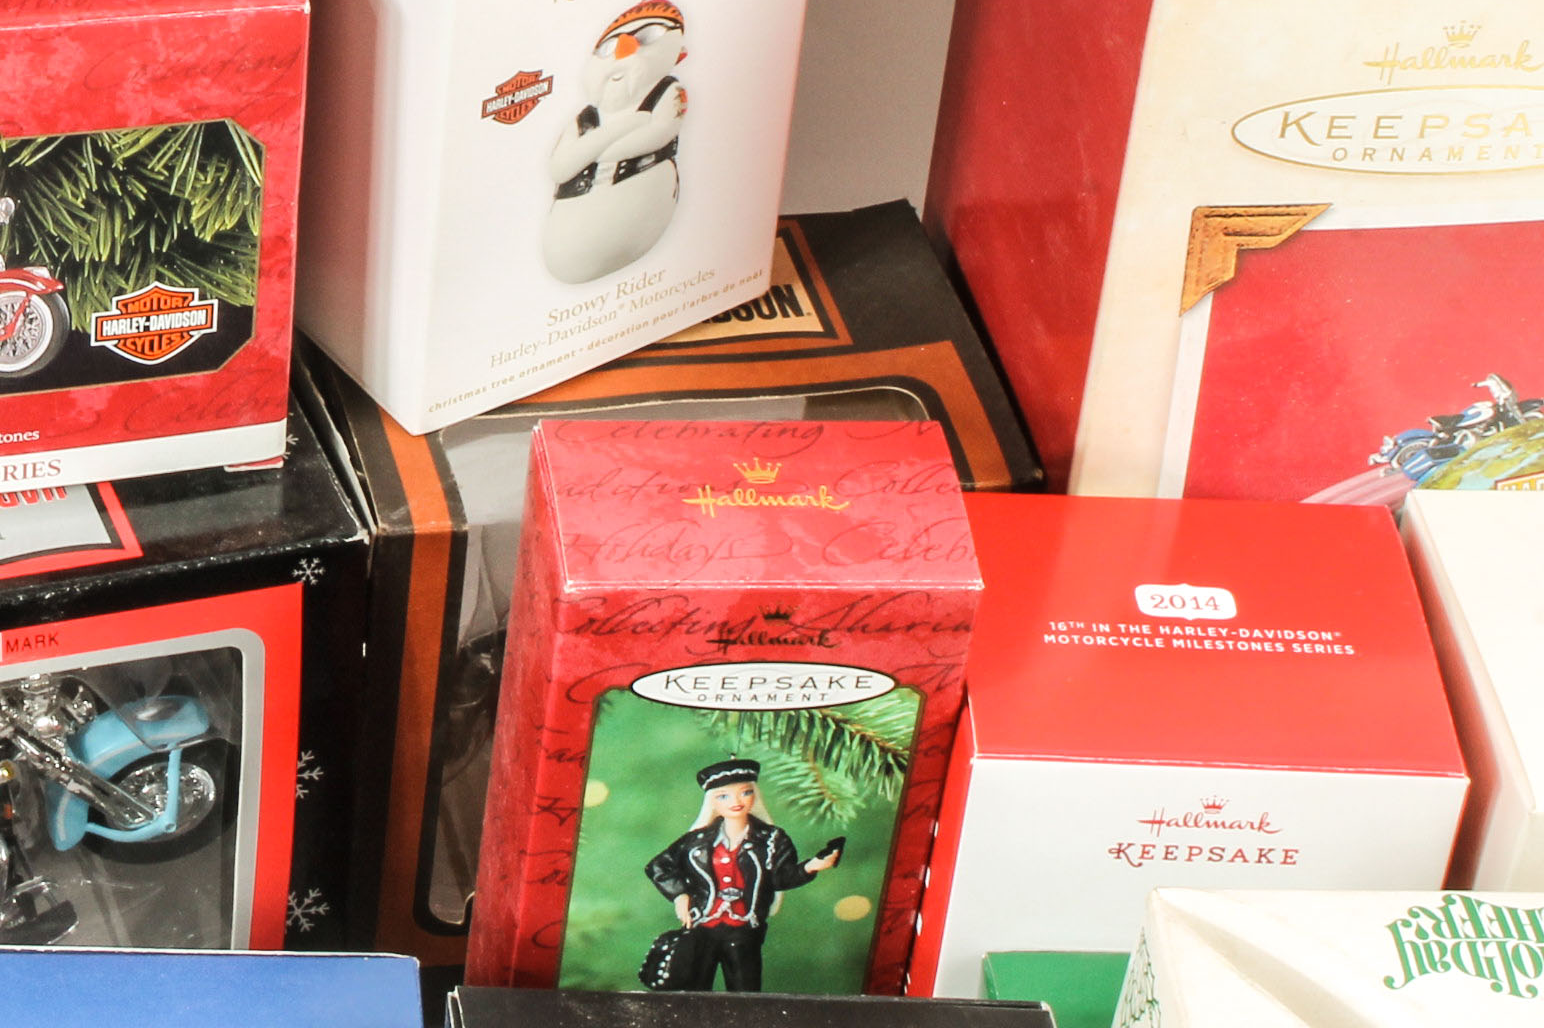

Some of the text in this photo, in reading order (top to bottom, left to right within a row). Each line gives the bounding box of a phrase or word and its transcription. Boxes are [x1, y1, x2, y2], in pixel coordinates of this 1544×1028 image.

[1363, 42, 1544, 85] Hallmark
[1278, 111, 1533, 146] KEEPSA
[127, 293, 184, 313] MOTOR
[547, 269, 666, 327] Snowy Rider
[629, 269, 716, 313] Motorcycles
[102, 309, 207, 337] HARLEY-DAVIDSON
[126, 333, 182, 355] CYCLES
[428, 386, 488, 413] christmas
[491, 375, 516, 390] tree
[519, 349, 577, 378] ornament
[682, 485, 851, 518] Hallmark
[1150, 594, 1220, 611] 2014
[1092, 623, 1111, 633] IN
[1117, 623, 1152, 635] THE
[6, 633, 60, 653] MARK
[706, 632, 844, 656] Hallmark
[1044, 634, 1355, 655] MOTORCYCLE MILESTONES SERIES
[664, 675, 874, 693] KEEPSAKE
[697, 693, 829, 703] ORNAMENT
[1136, 807, 1283, 837] Hallmark
[1108, 843, 1300, 868] KEEPSAKE
